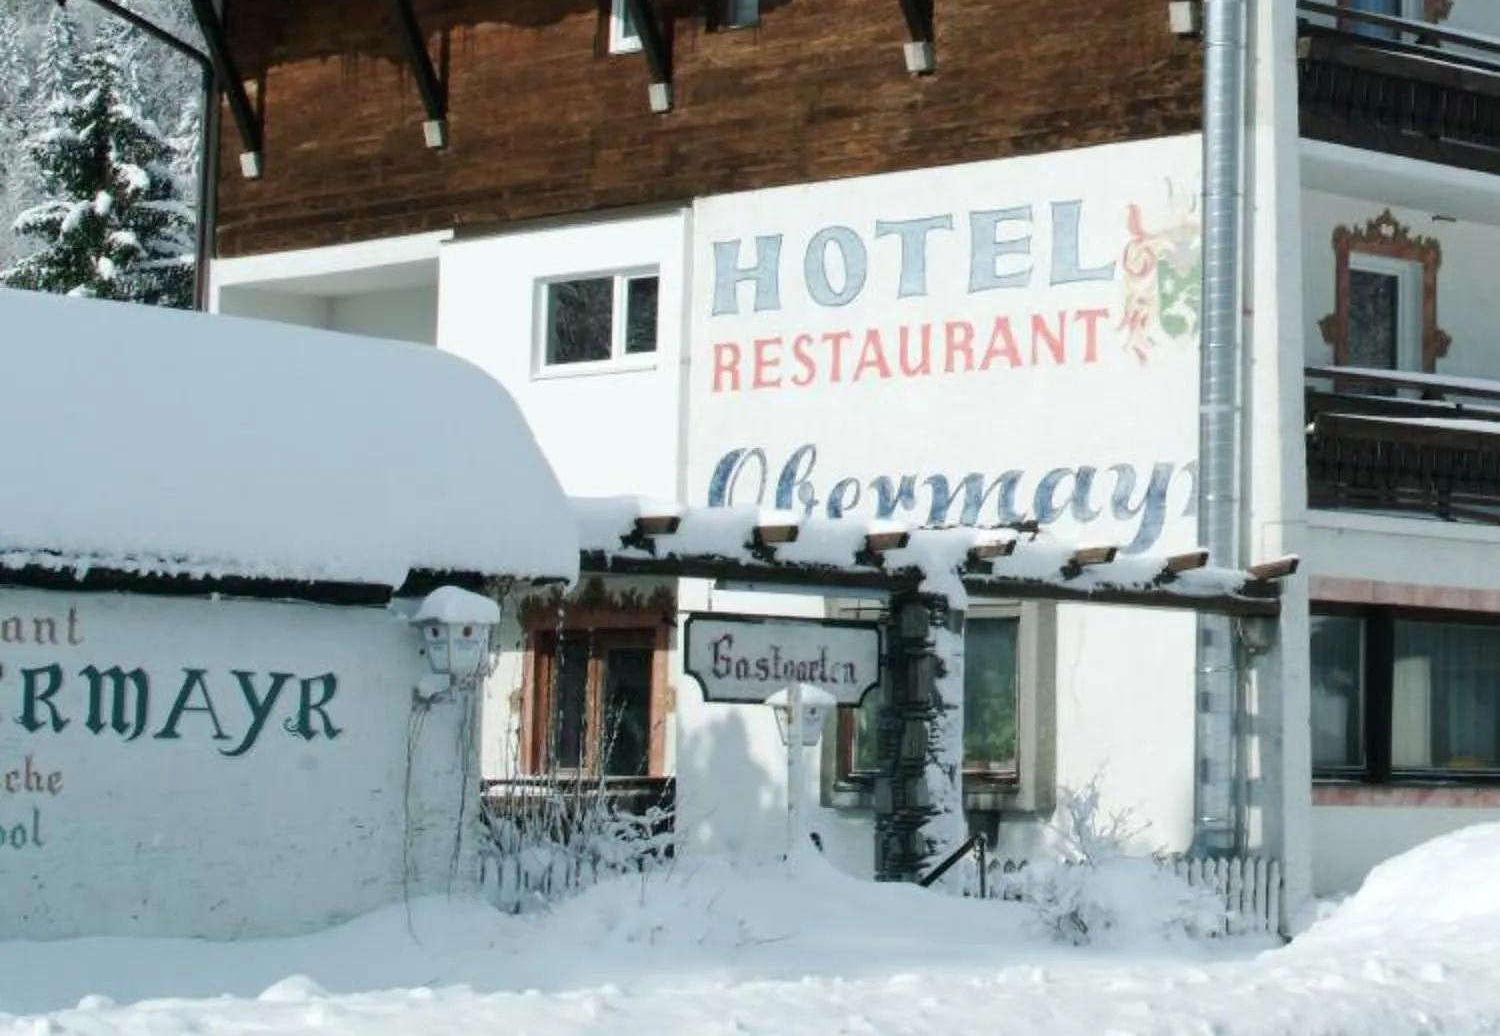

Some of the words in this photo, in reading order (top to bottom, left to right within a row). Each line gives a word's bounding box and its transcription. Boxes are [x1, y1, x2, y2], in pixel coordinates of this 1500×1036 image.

[710, 198, 1117, 317] HOTEL
[711, 306, 1111, 393] RESTAURANT
[0, 661, 343, 757] RMAYR
